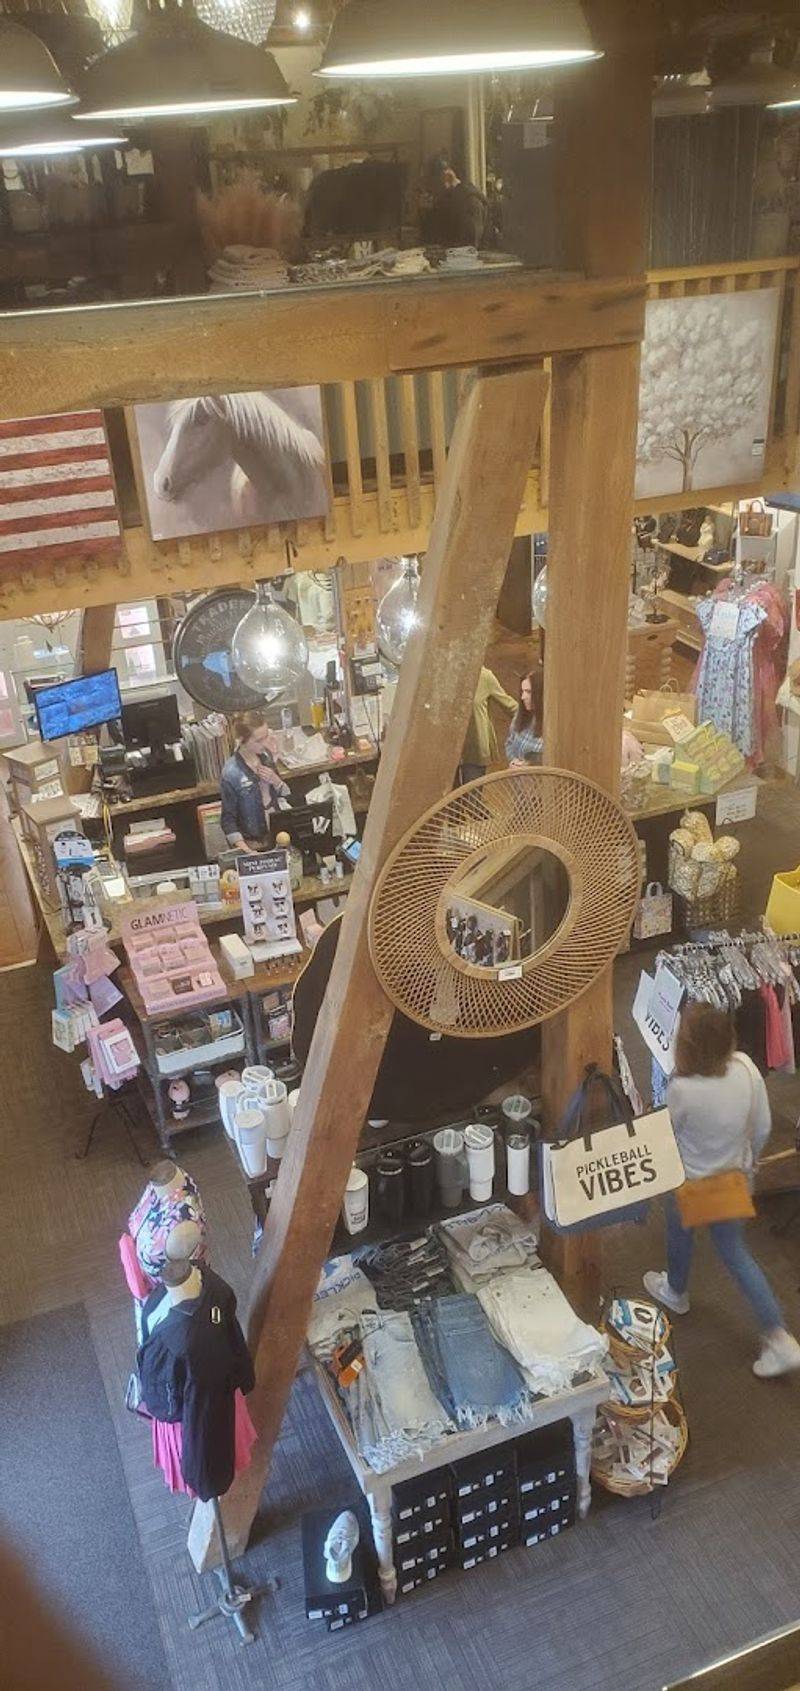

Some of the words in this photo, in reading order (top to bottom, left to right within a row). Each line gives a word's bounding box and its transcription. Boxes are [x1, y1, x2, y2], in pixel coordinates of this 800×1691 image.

[130, 906, 188, 930] GLAMNETIC
[576, 1144, 652, 1178] PICKLEBALL
[579, 1158, 657, 1201] VIBES
